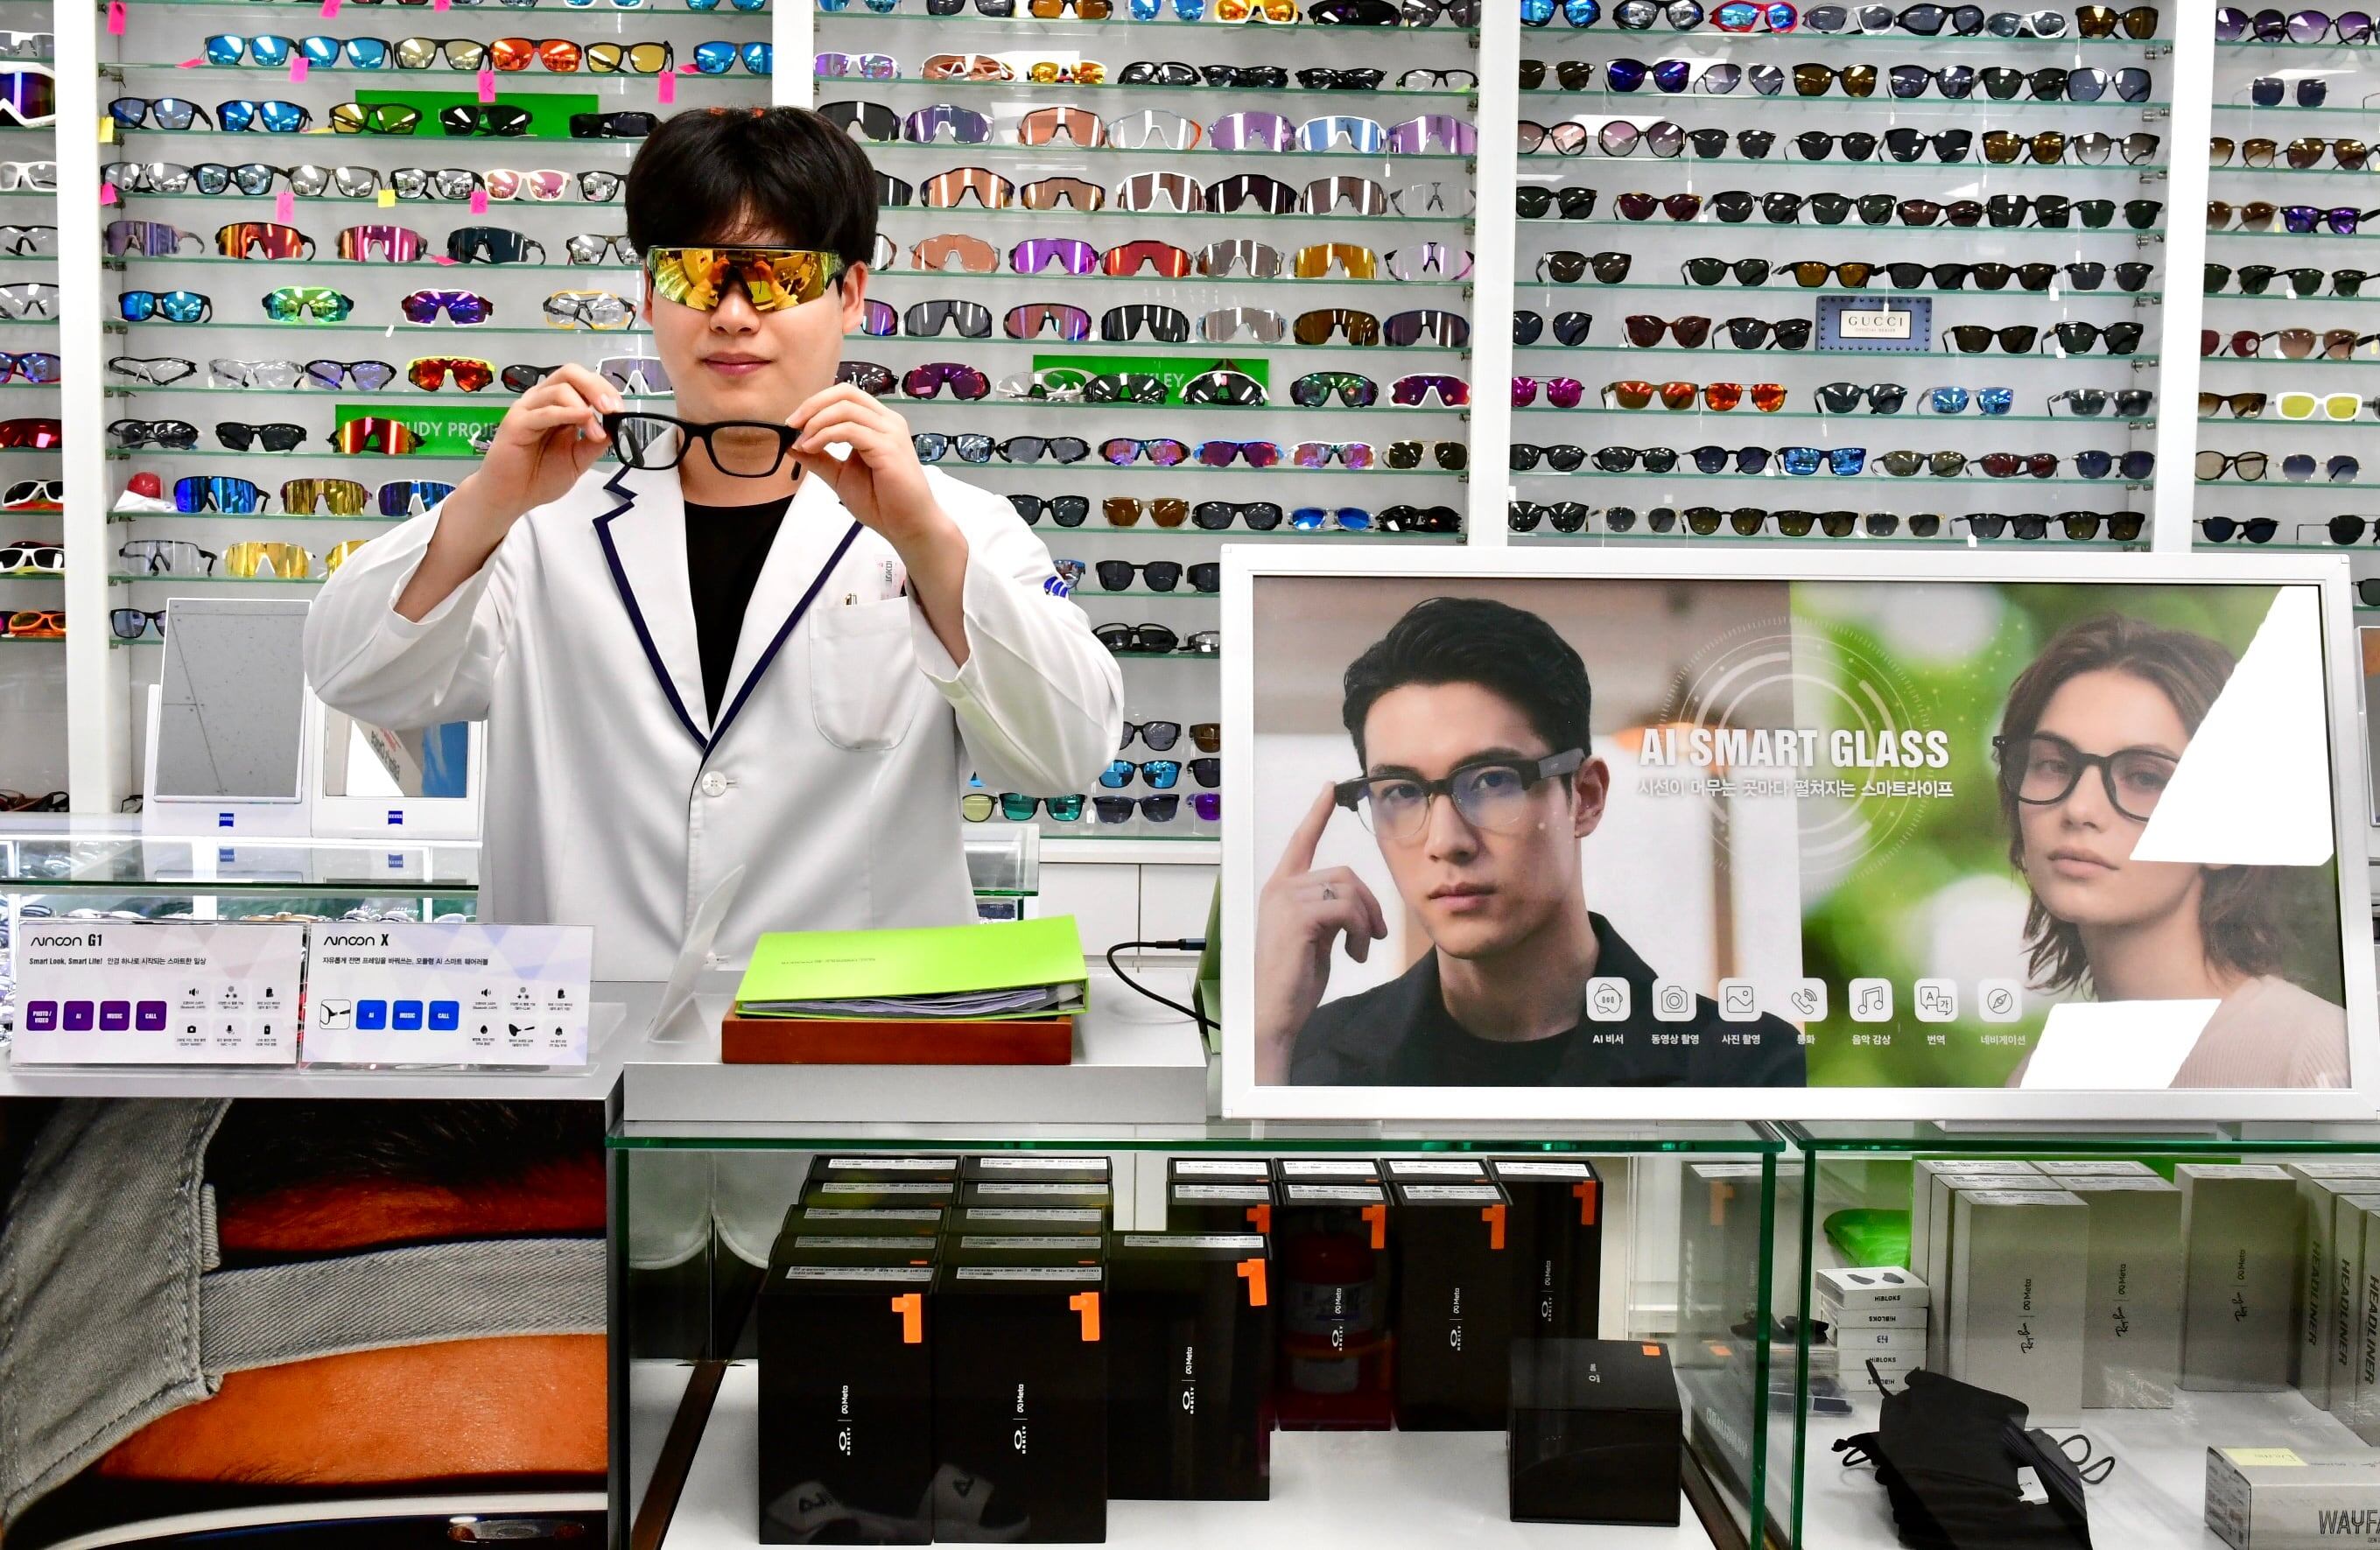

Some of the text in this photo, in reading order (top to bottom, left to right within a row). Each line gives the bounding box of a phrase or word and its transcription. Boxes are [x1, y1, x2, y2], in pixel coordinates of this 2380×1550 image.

[1849, 316, 1903, 326] GUCCI
[397, 421, 443, 437] UDY
[1639, 728, 1949, 768] AI SMART GLASS
[1639, 779, 1955, 798] 시선이 머무는 곳마다 펼쳐지는 스마트라이프
[88, 934, 102, 947] G1
[380, 933, 390, 946] X
[50, 957, 67, 966] Look,
[1592, 1034, 1624, 1045] AI 비서
[1651, 1034, 1699, 1045] 동영상 촬영
[1722, 1034, 1760, 1045] 사진 촬영
[1796, 1034, 1815, 1045] 통화
[1851, 1035, 1891, 1045] 음악 감상
[1927, 1035, 1946, 1045] 번역
[1980, 1035, 2026, 1046] 네비게이션
[2308, 1240, 2320, 1346] HEADLINER
[2338, 1258, 2350, 1366] HEADLINER
[2364, 1274, 2380, 1385] HEADLINER
